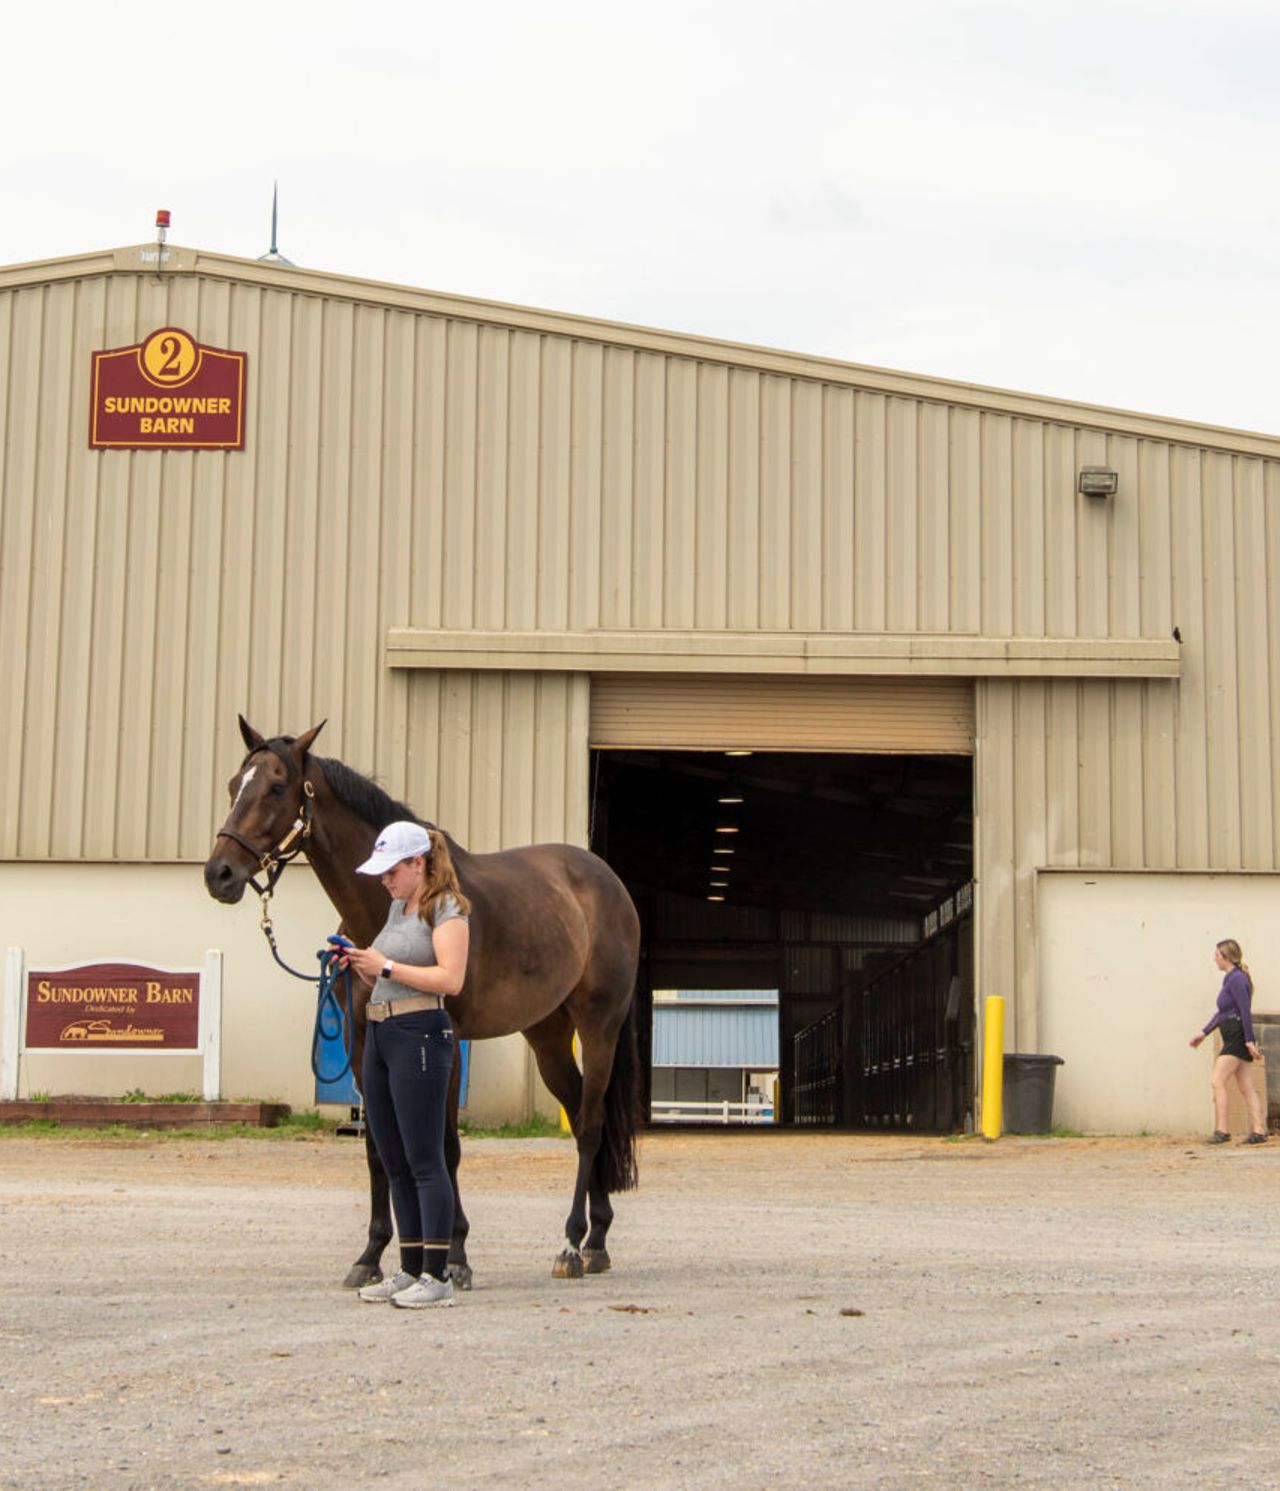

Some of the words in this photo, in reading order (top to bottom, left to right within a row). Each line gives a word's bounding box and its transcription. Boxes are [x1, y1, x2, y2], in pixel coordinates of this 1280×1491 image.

[158, 336, 182, 376] 2
[104, 397, 231, 414] SUNDOWNER
[140, 417, 194, 434] BARN
[38, 980, 138, 1003] SUNDOWNER
[146, 981, 193, 1003] BARN
